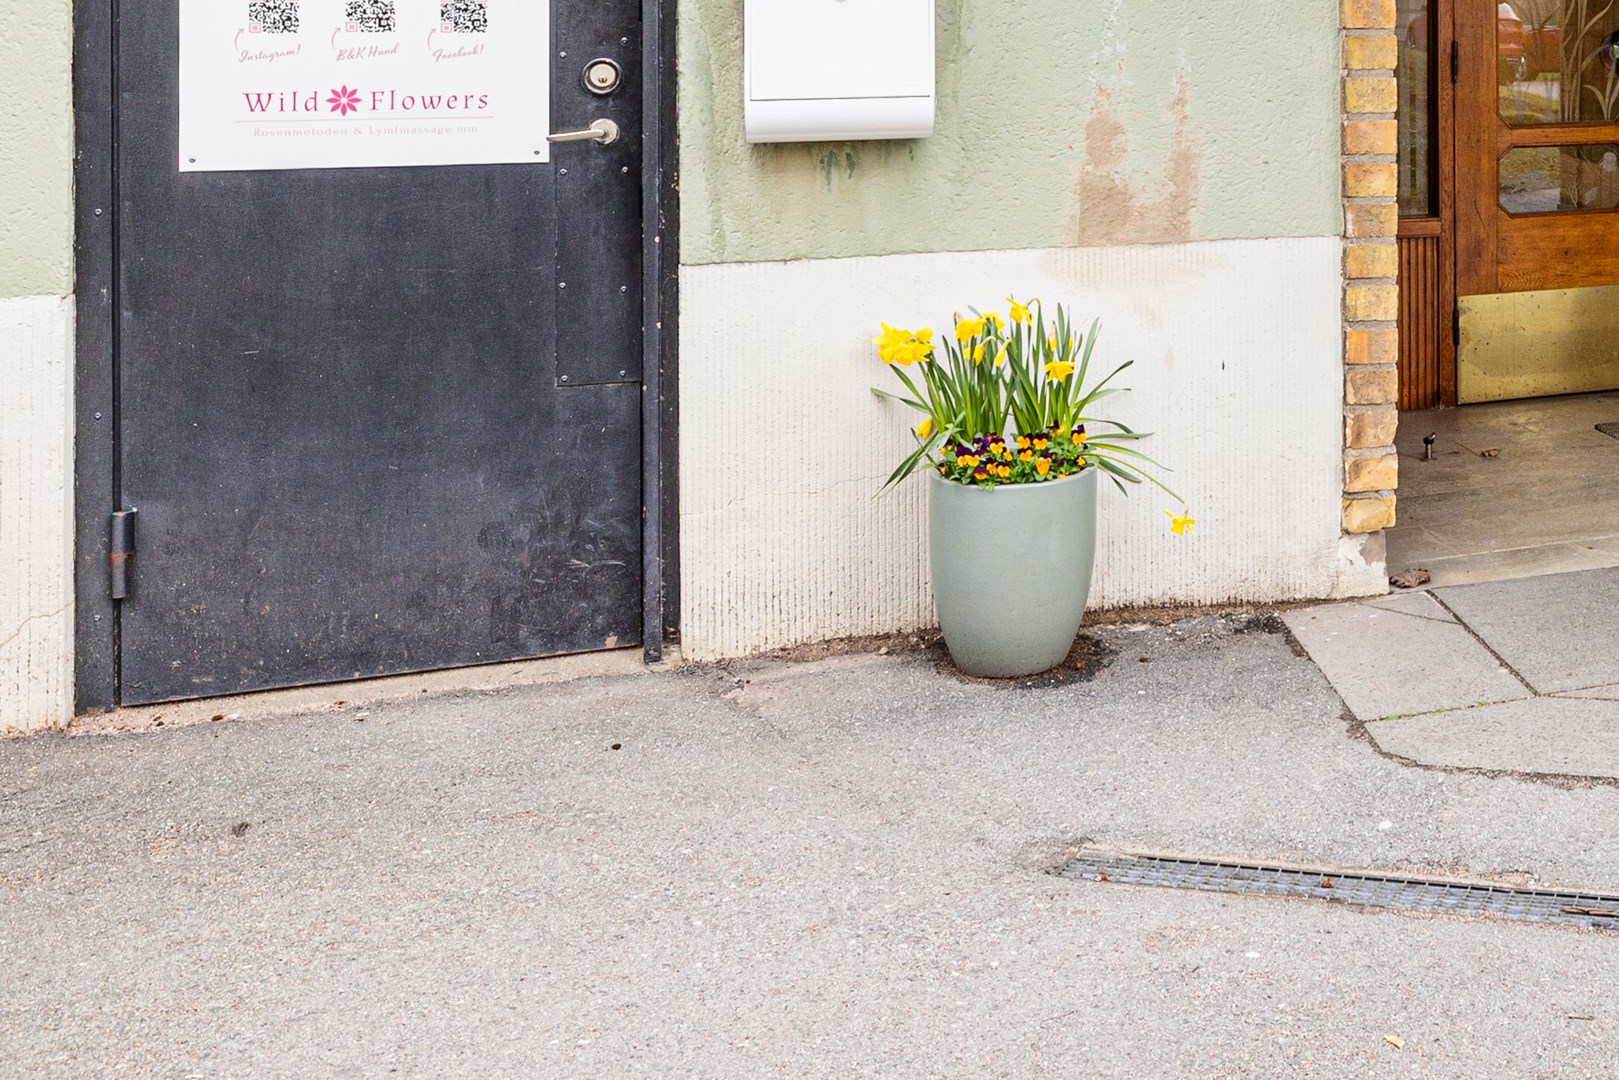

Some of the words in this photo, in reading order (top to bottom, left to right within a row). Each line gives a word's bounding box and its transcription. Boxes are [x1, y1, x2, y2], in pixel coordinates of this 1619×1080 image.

[238, 43, 302, 62] Instagram!
[335, 46, 367, 62] B&K
[367, 42, 400, 58] Hund
[432, 43, 485, 62] Facebook!
[242, 90, 318, 113] Wild
[369, 88, 489, 112] Flowers
[253, 127, 348, 137] Rosenmetoden
[352, 127, 364, 136] &
[369, 125, 452, 137] Lymfmassage
[457, 125, 479, 133] mm
